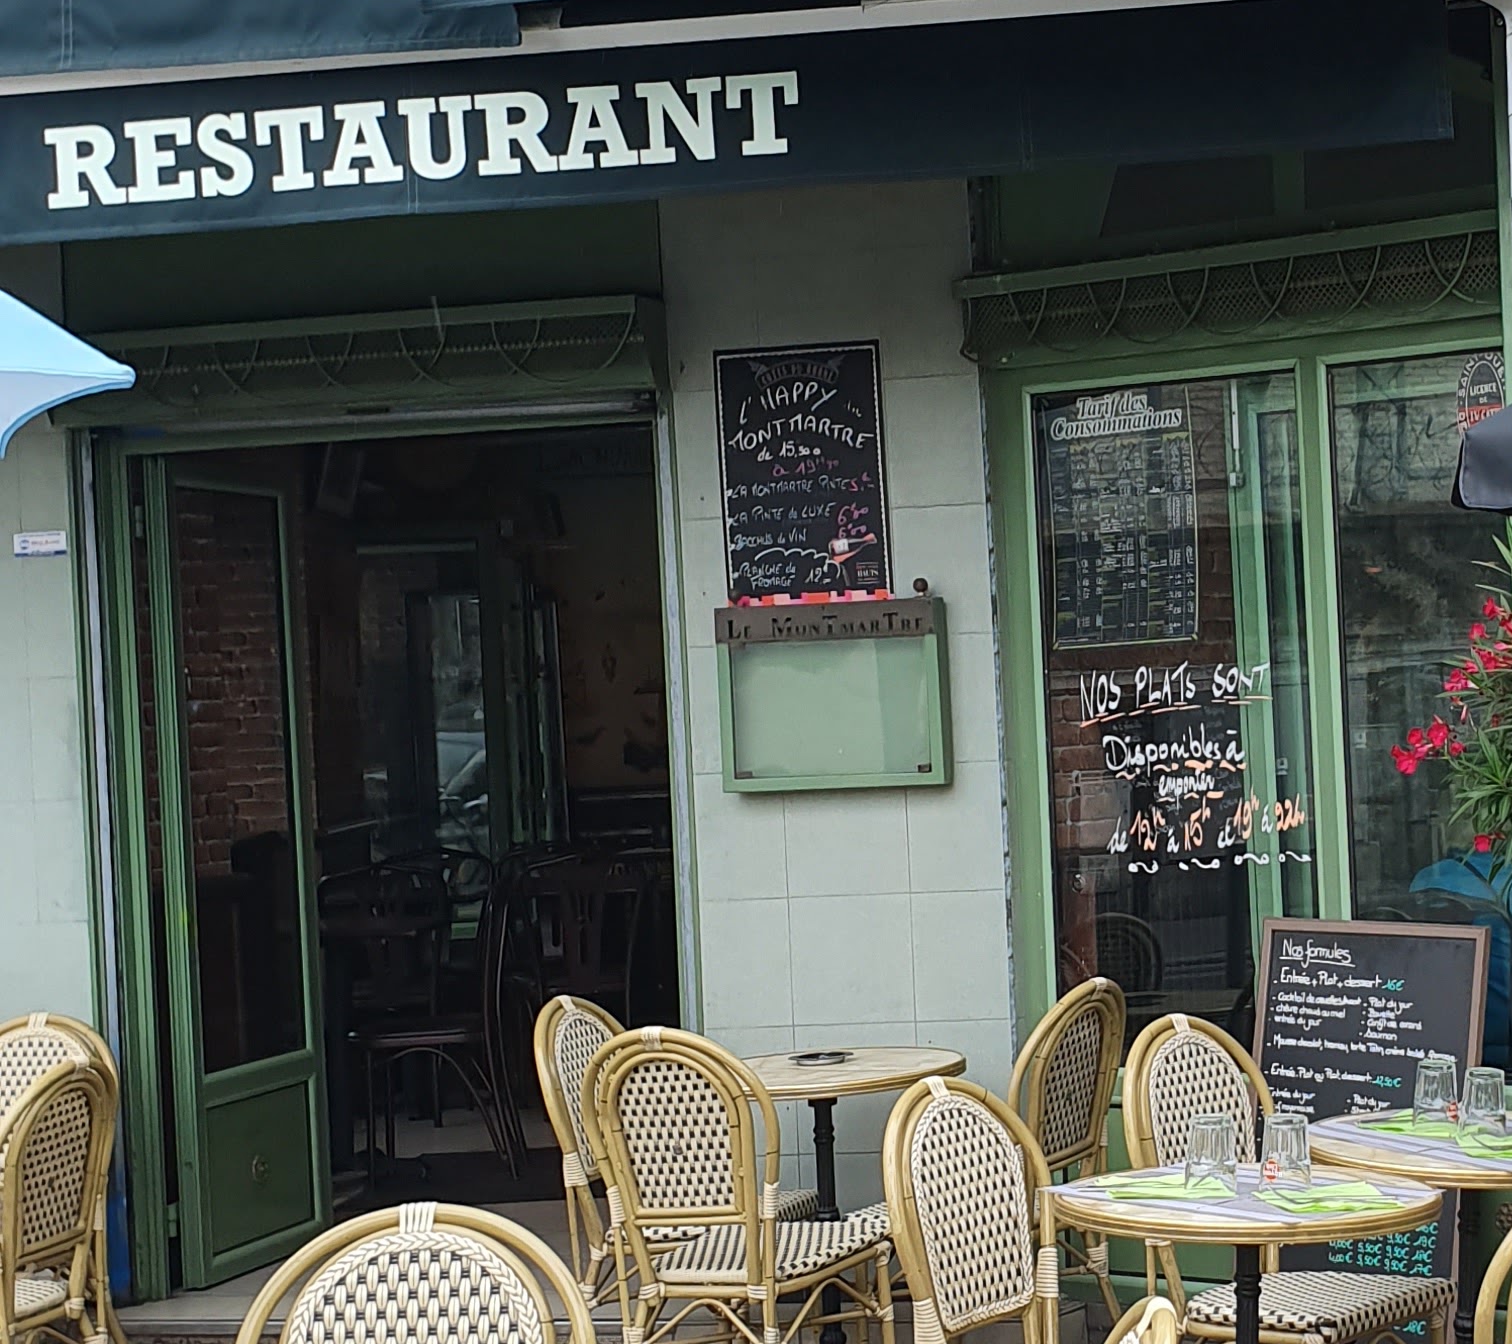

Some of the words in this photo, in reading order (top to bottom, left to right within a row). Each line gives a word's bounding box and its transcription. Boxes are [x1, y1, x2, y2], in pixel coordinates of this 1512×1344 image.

[43, 70, 800, 211] RESTAURANT
[1076, 395, 1119, 419] Tarif
[1118, 392, 1148, 413] des
[1469, 382, 1497, 396] LICENCE
[728, 413, 875, 451] MONTMARTRE
[1051, 407, 1183, 440] Consommations
[752, 479, 813, 496] MONTMARTRE
[801, 502, 837, 518] LUXE
[788, 527, 807, 543] VIN
[1080, 670, 1121, 721] NOS
[1211, 663, 1271, 698] SONT
[1103, 723, 1221, 776] Disponibles
[1159, 771, 1215, 814] emporter
[1107, 816, 1129, 854] de
[1130, 806, 1165, 851] 12h
[1282, 938, 1303, 957] Nos
[1301, 939, 1352, 968] formules
